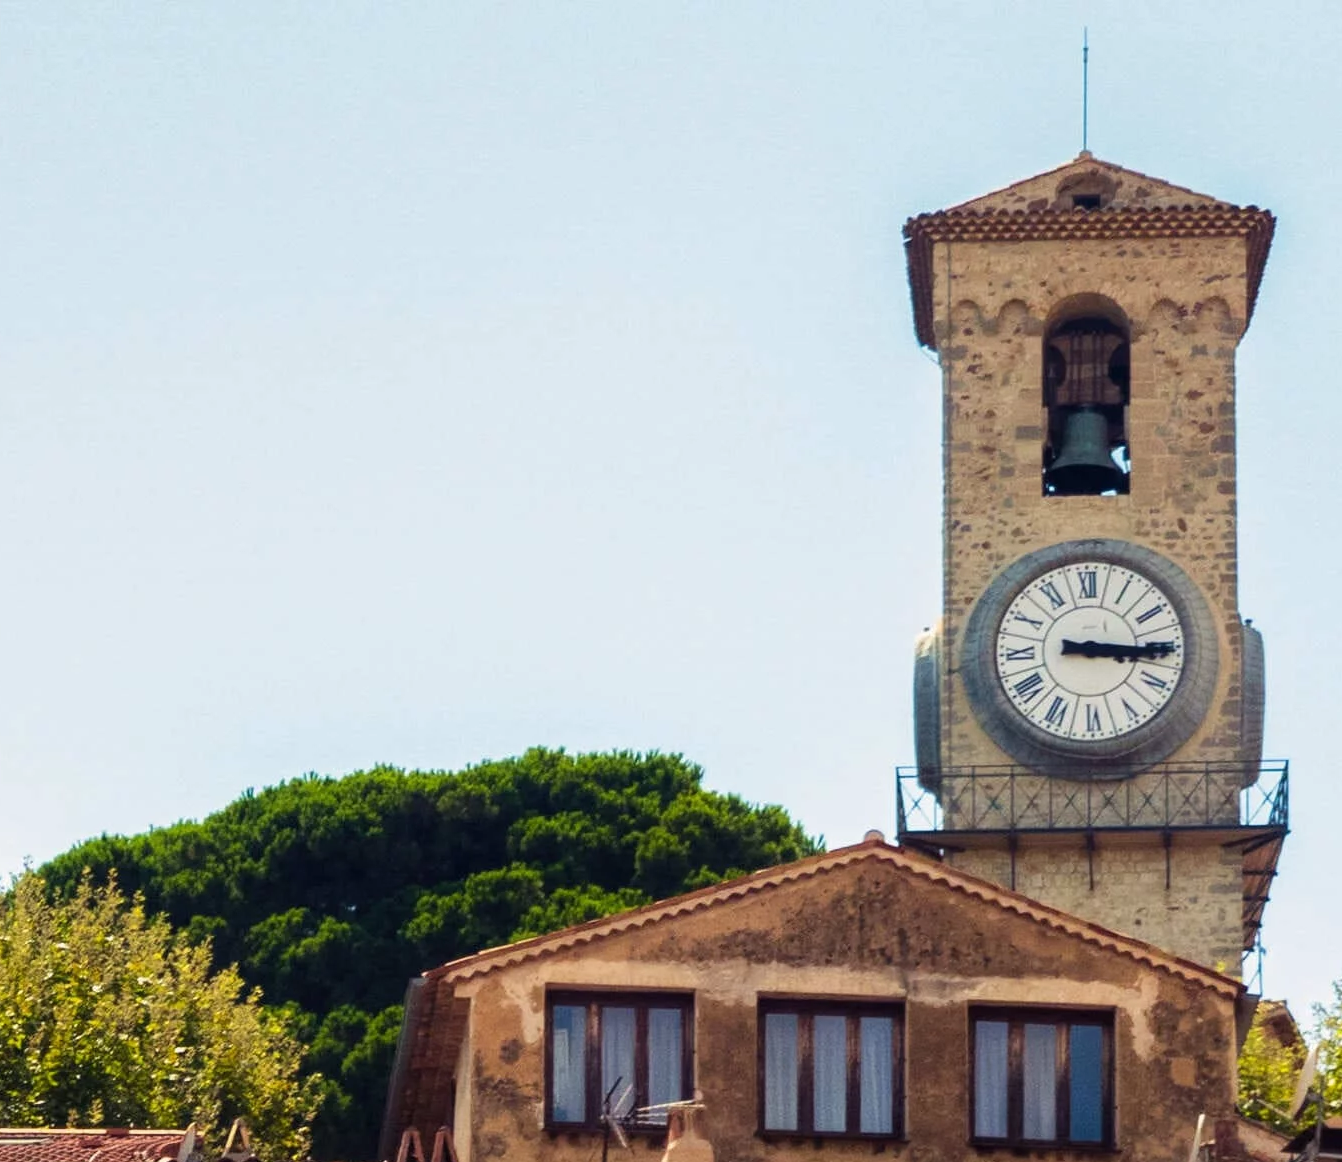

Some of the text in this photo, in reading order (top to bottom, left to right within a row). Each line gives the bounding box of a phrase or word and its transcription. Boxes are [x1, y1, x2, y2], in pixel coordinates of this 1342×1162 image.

[1039, 581, 1066, 610] XI
[1077, 571, 1097, 599] XII
[1114, 579, 1132, 605] I
[1013, 610, 1044, 631] X
[1135, 605, 1163, 624] II
[1006, 646, 1035, 661] IX
[1013, 672, 1045, 704] VIII
[1141, 670, 1168, 695] IV
[1044, 696, 1069, 727] VII
[1086, 704, 1101, 732] VI
[1121, 698, 1140, 722] V
